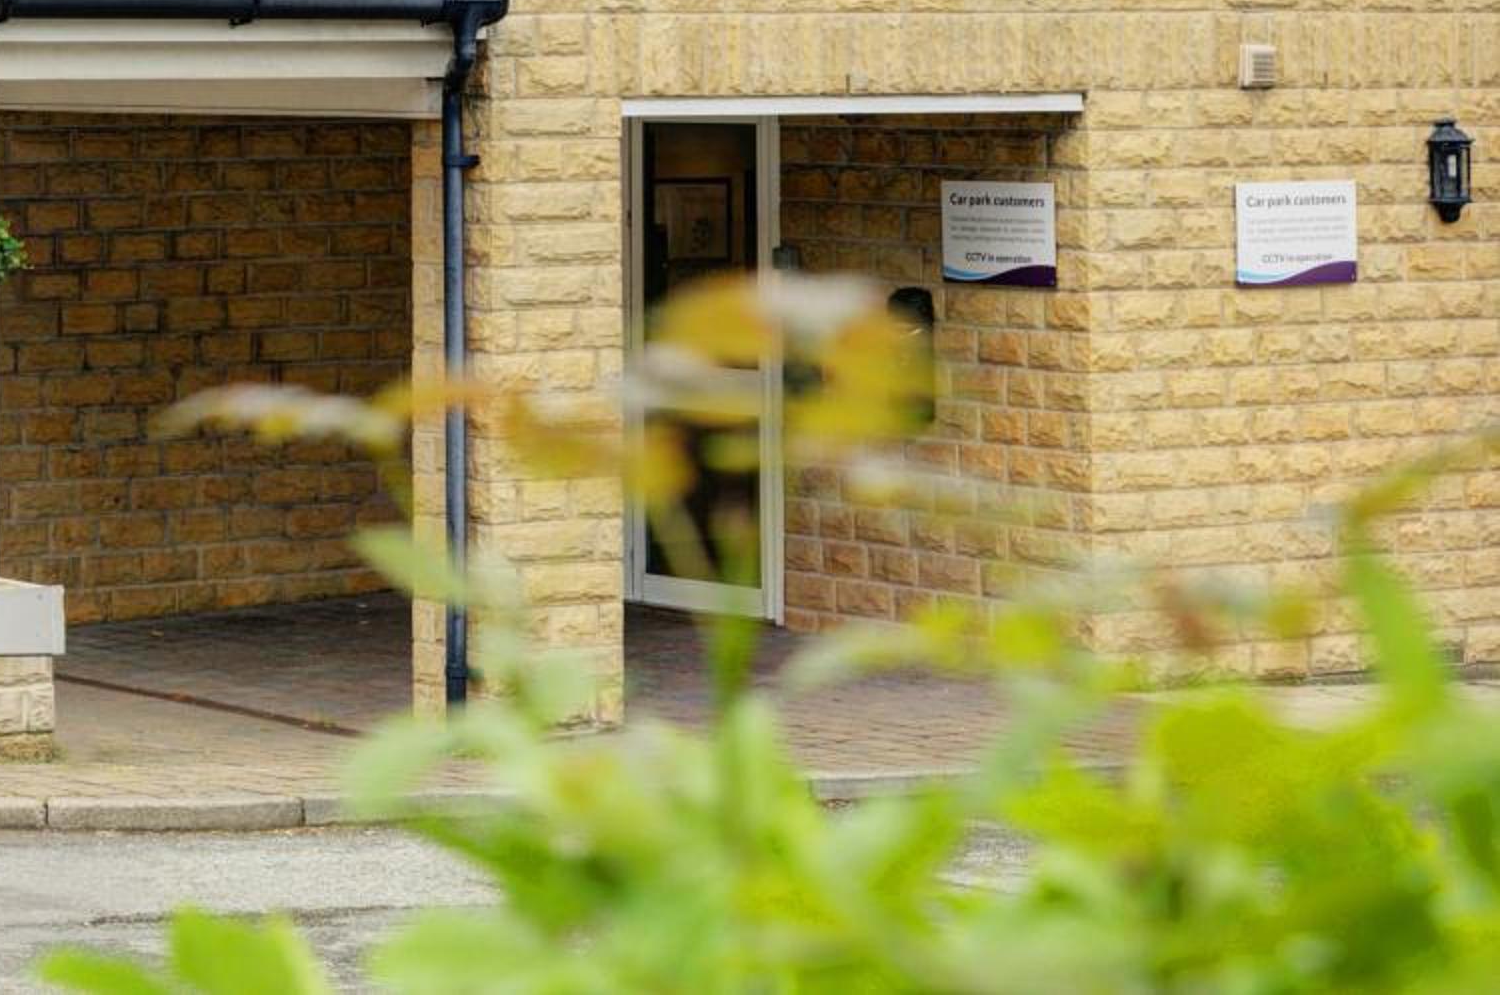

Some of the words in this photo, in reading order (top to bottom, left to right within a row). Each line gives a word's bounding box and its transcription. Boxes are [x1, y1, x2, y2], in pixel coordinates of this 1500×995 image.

[949, 192, 967, 206] Car
[969, 192, 991, 208] park
[993, 195, 1045, 208] customers
[1246, 195, 1265, 208] Car
[1267, 194, 1292, 209] park
[1293, 194, 1347, 206] customers
[965, 252, 987, 262] CCTV
[1261, 253, 1285, 264] CCTV
